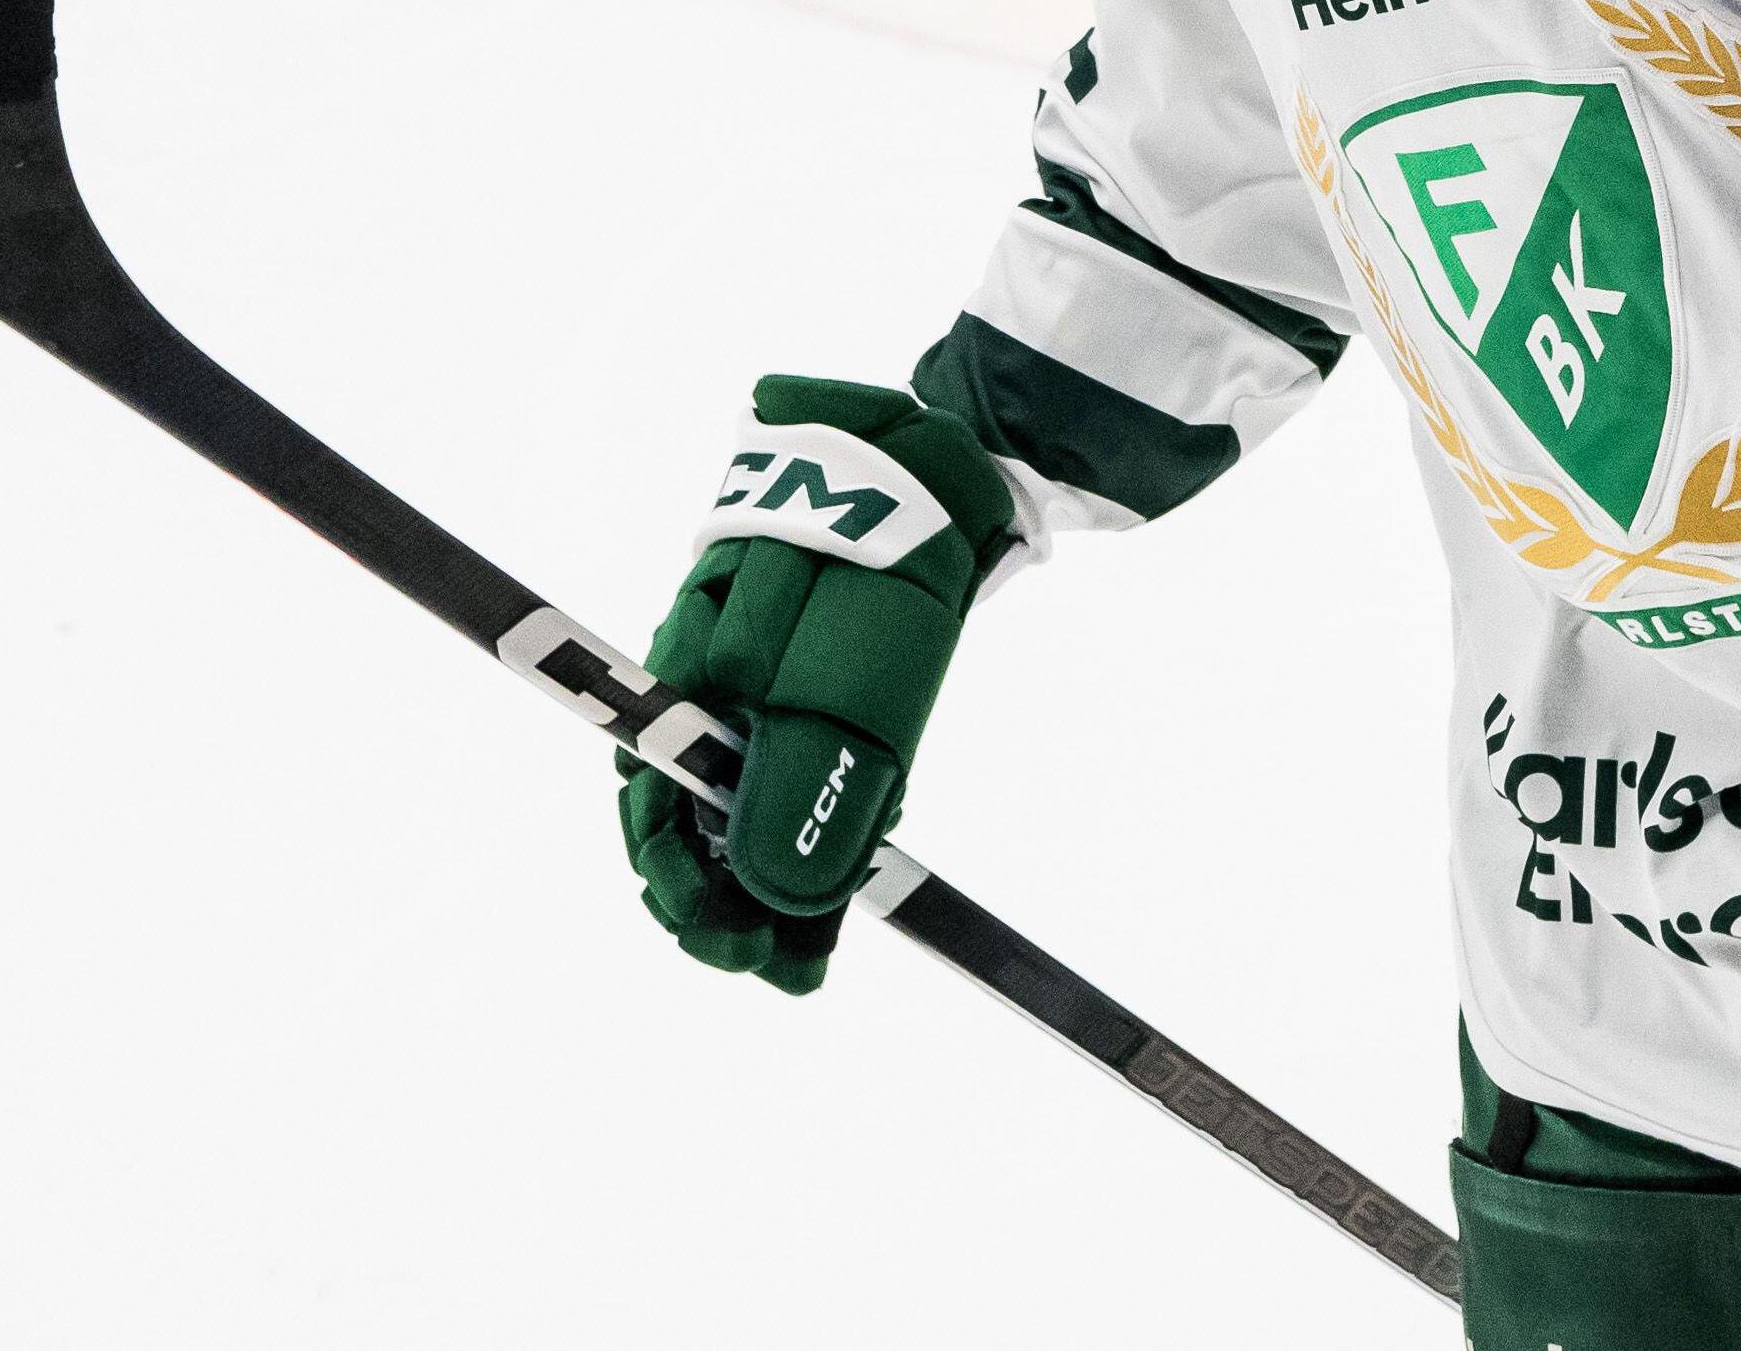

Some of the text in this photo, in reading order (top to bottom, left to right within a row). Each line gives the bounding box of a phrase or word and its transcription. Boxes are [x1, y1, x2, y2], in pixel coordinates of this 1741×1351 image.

[1526, 211, 1627, 429] BK
[714, 452, 901, 542] CM
[796, 747, 855, 856] CCM
